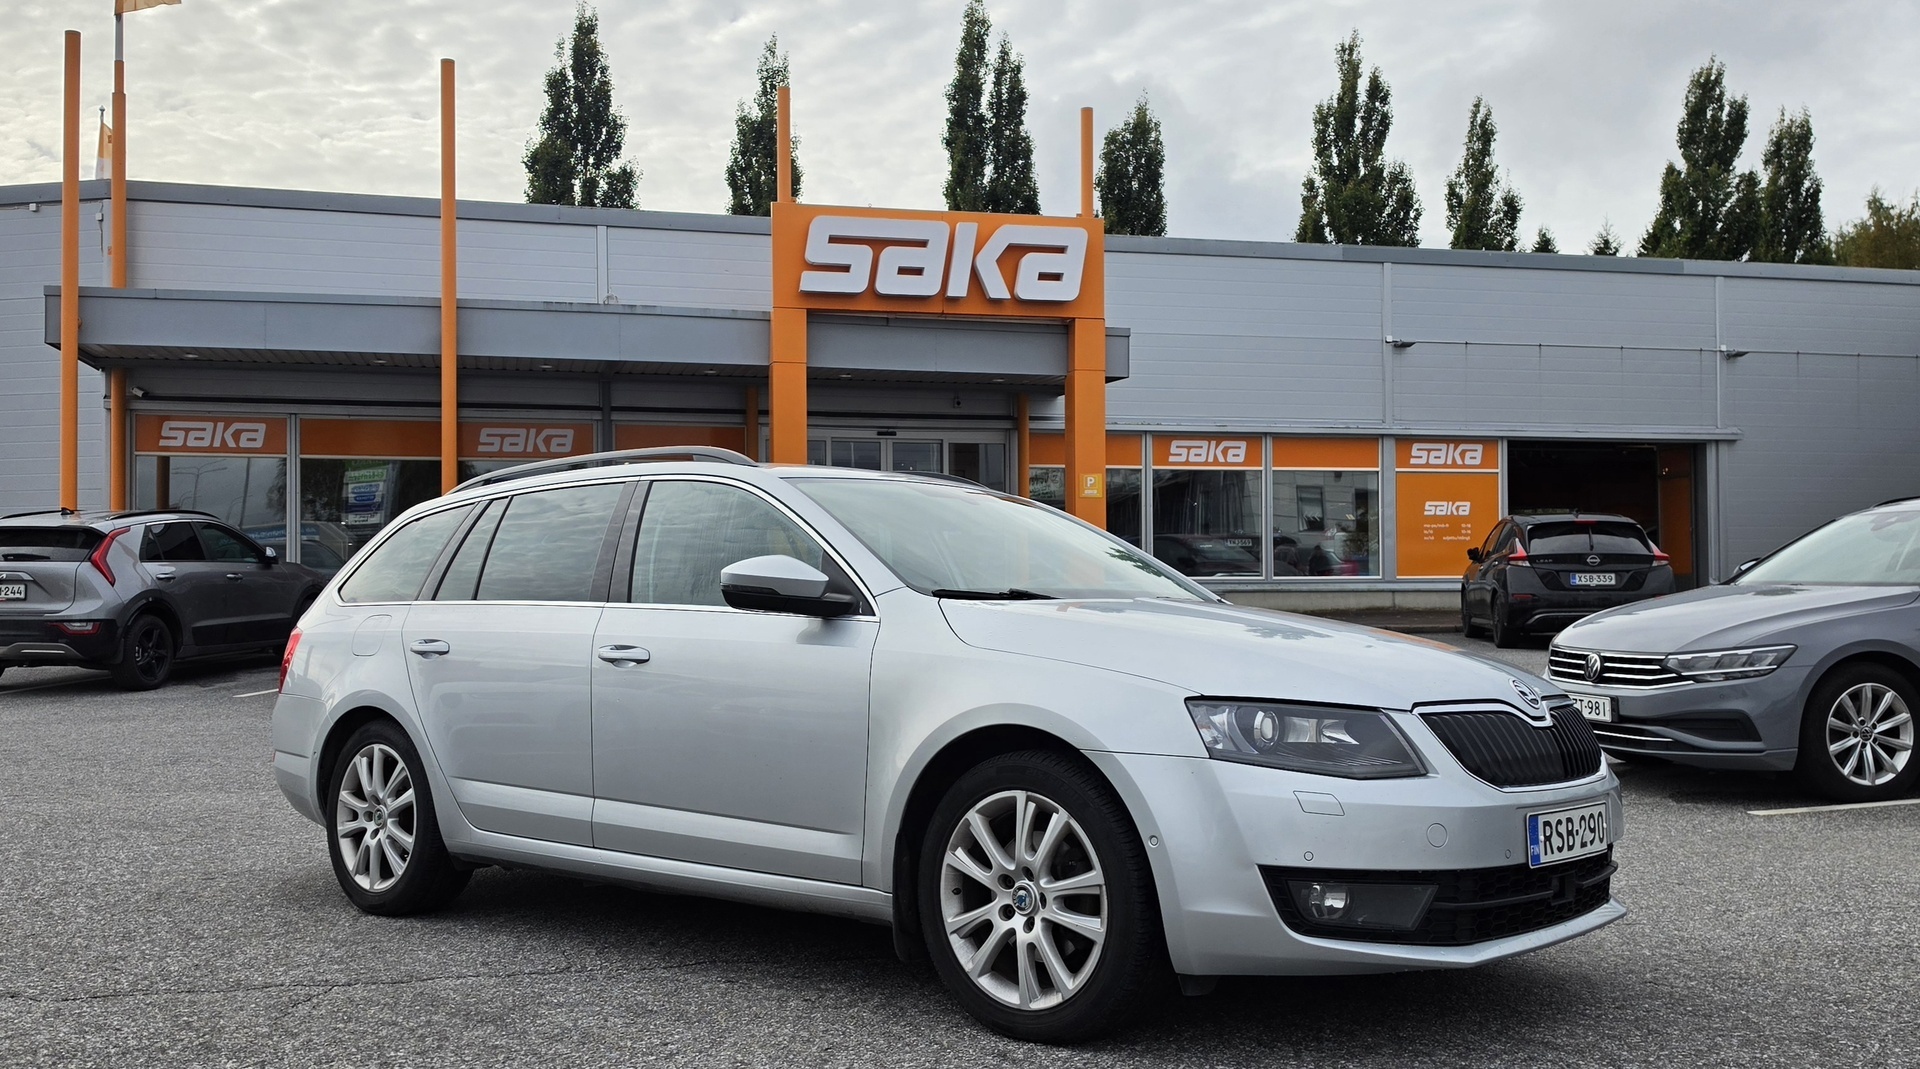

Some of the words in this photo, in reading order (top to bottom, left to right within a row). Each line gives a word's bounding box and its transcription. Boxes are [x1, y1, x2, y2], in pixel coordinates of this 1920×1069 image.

[1577, 574, 1613, 583] XSB-339
[0, 586, 22, 596] -244
[1543, 811, 1605, 856] RSB-290
